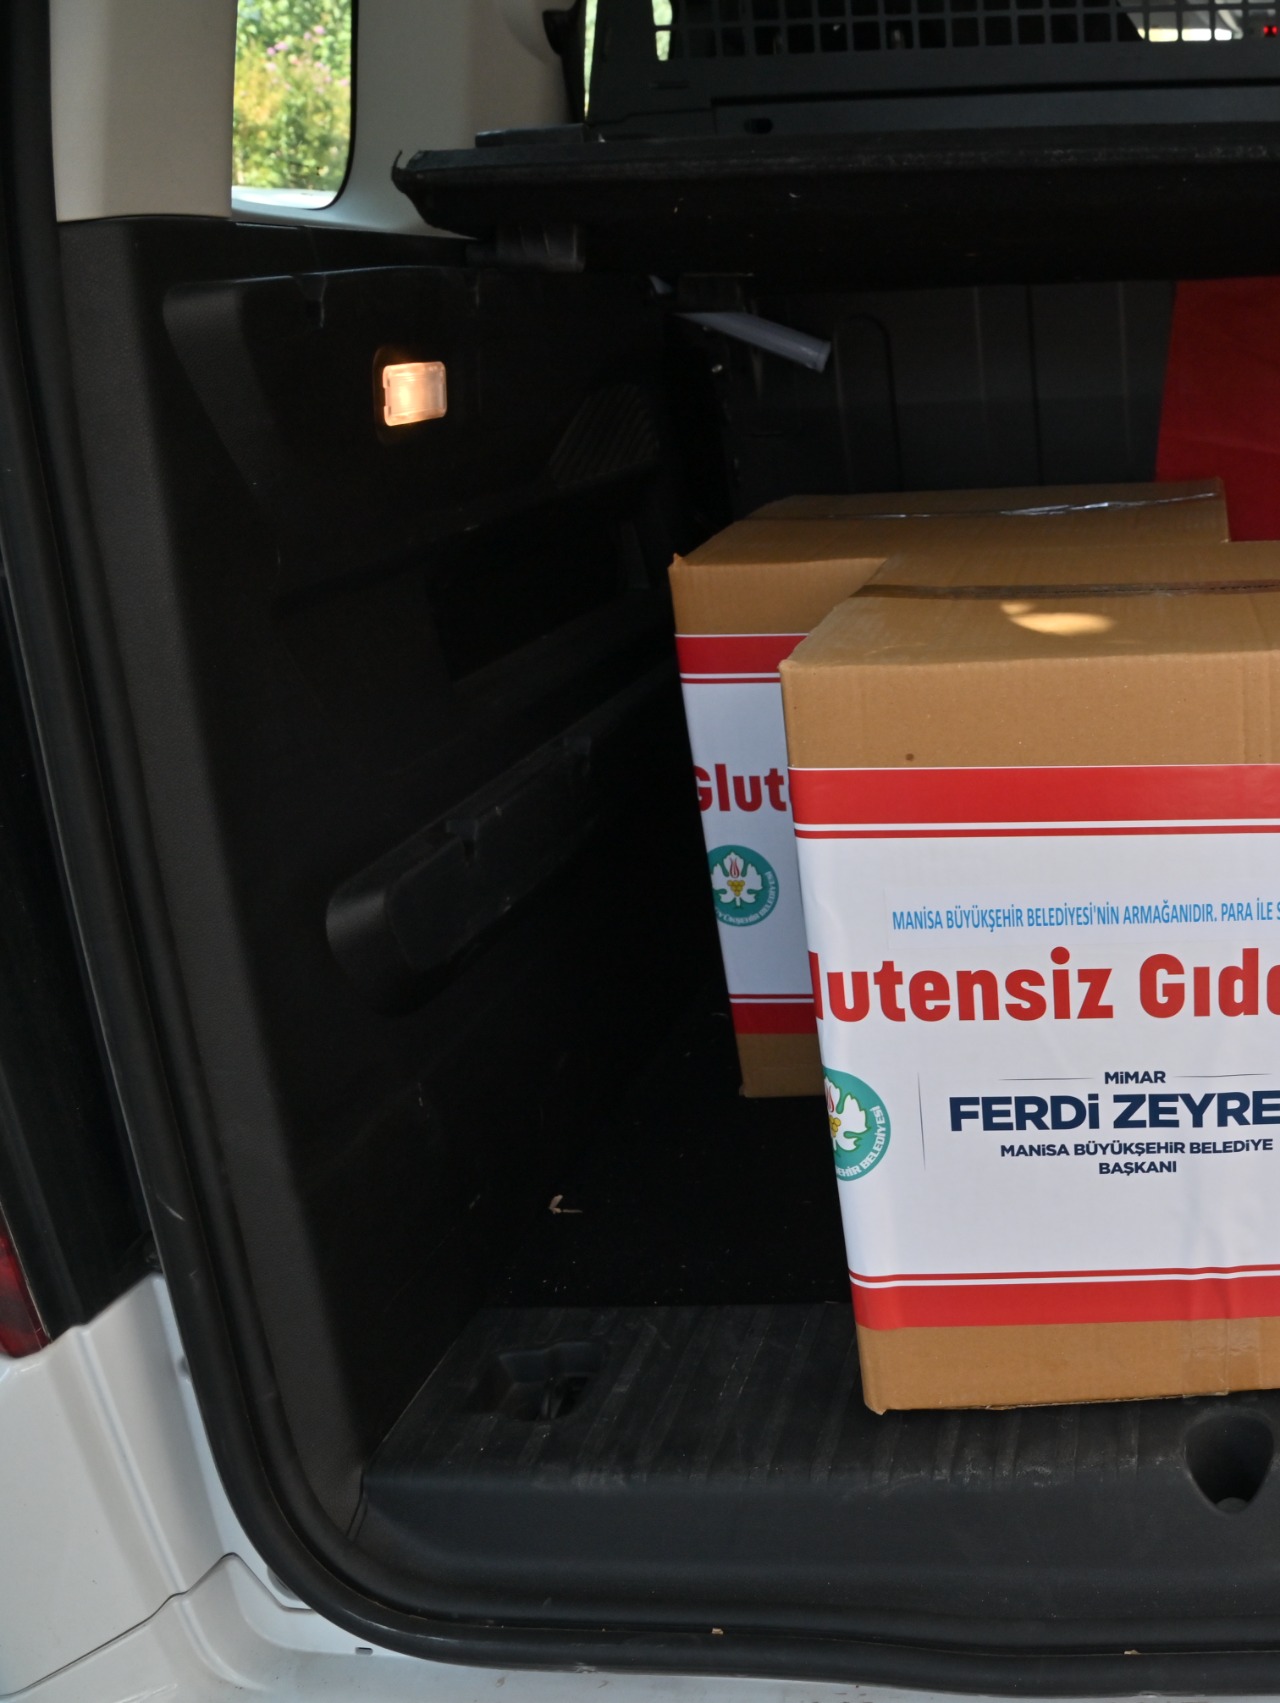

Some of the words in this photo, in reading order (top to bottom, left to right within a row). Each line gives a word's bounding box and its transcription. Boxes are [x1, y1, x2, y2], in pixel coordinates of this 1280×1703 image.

[694, 764, 793, 812] Glut
[892, 906, 943, 930] MANİSA
[946, 904, 1024, 932] BÜYÜKŞEHİR
[1027, 901, 1119, 927] BELEDİYESİ'NİN
[1122, 899, 1217, 925] ARMAĞANIDIR.
[1221, 901, 1253, 922] PARA
[1256, 897, 1273, 921] İLE
[807, 946, 1114, 1022] lutensiz
[1098, 1160, 1177, 1177] BAŞKANI
